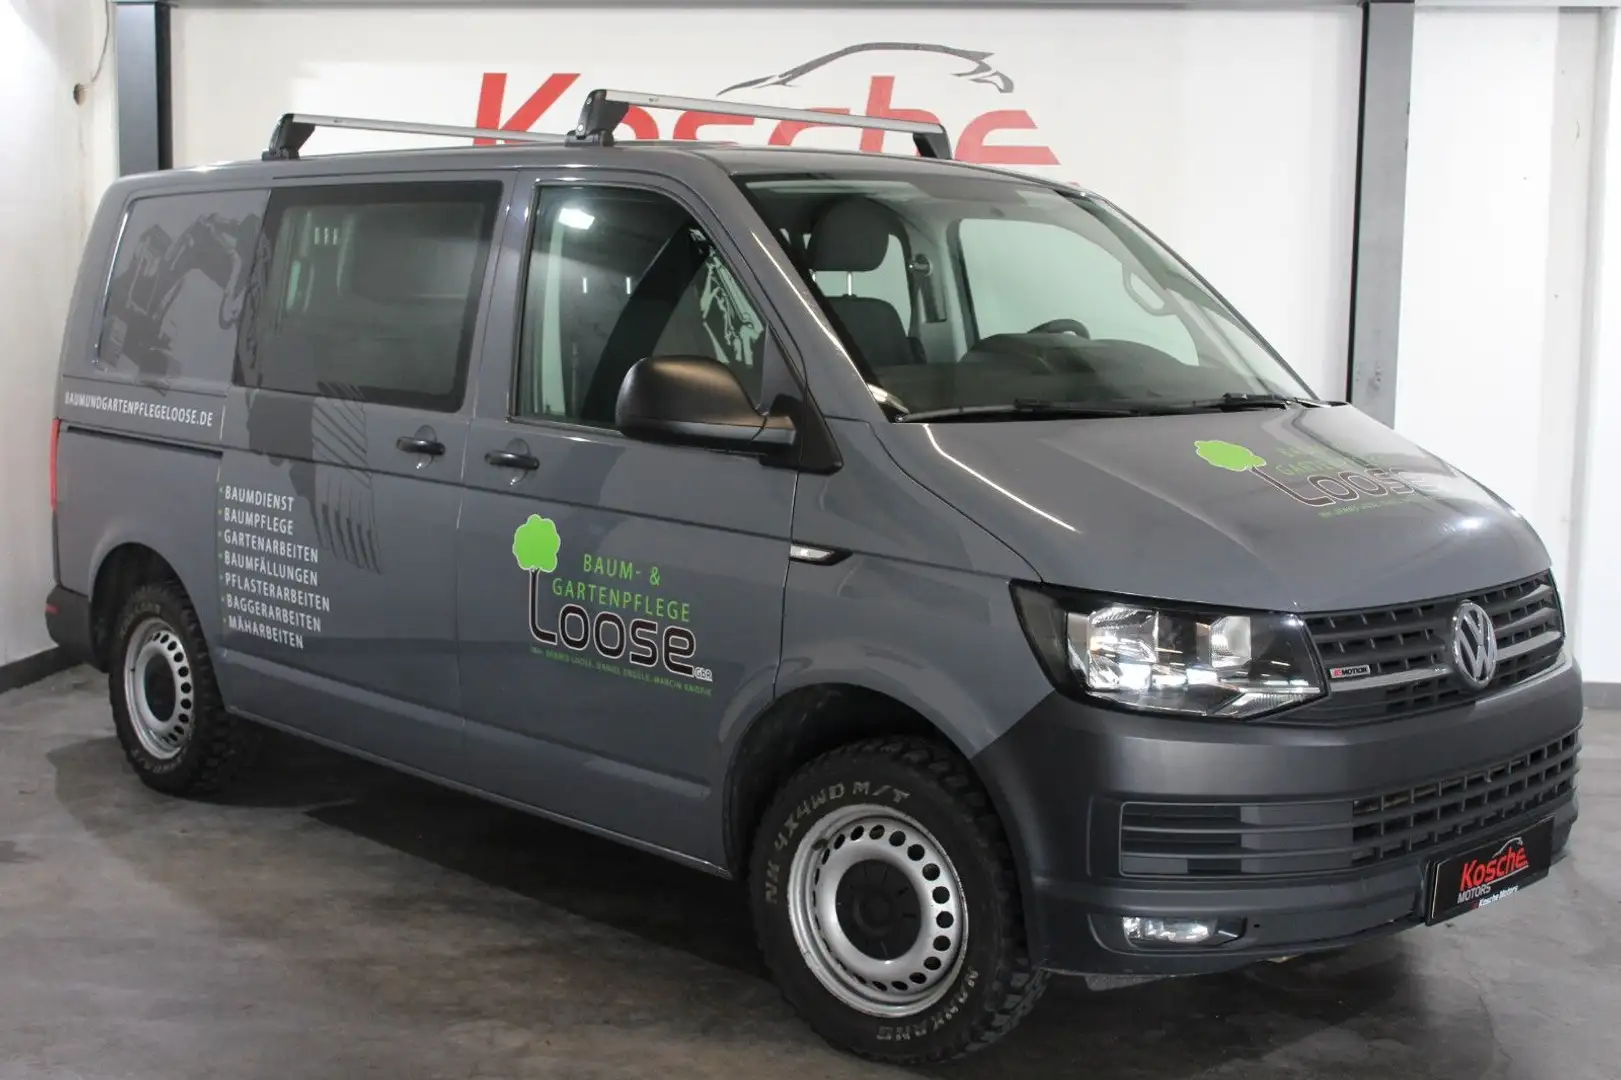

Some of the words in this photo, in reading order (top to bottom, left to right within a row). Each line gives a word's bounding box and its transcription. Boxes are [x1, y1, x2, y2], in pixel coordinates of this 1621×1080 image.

[64, 391, 213, 427] BAUMUNDGARTENPFLEGELOOSE.DE
[225, 485, 295, 512] BAUMDIENST
[224, 507, 294, 535] BAUMPFLEGE
[224, 529, 319, 564] GARTENARBEITEN
[224, 551, 318, 586] BAUMFÄLLUNGEN
[583, 553, 641, 580] BAUM-
[649, 566, 661, 586] &
[225, 572, 330, 612] PFLASTERARBEITEN
[552, 577, 690, 622] GARTENPFLEGE
[226, 594, 321, 632] BAGGERARBEITEN
[852, 780, 912, 803] M/T
[1459, 844, 1529, 891] Kosche
[1457, 883, 1492, 904] MOTORS
